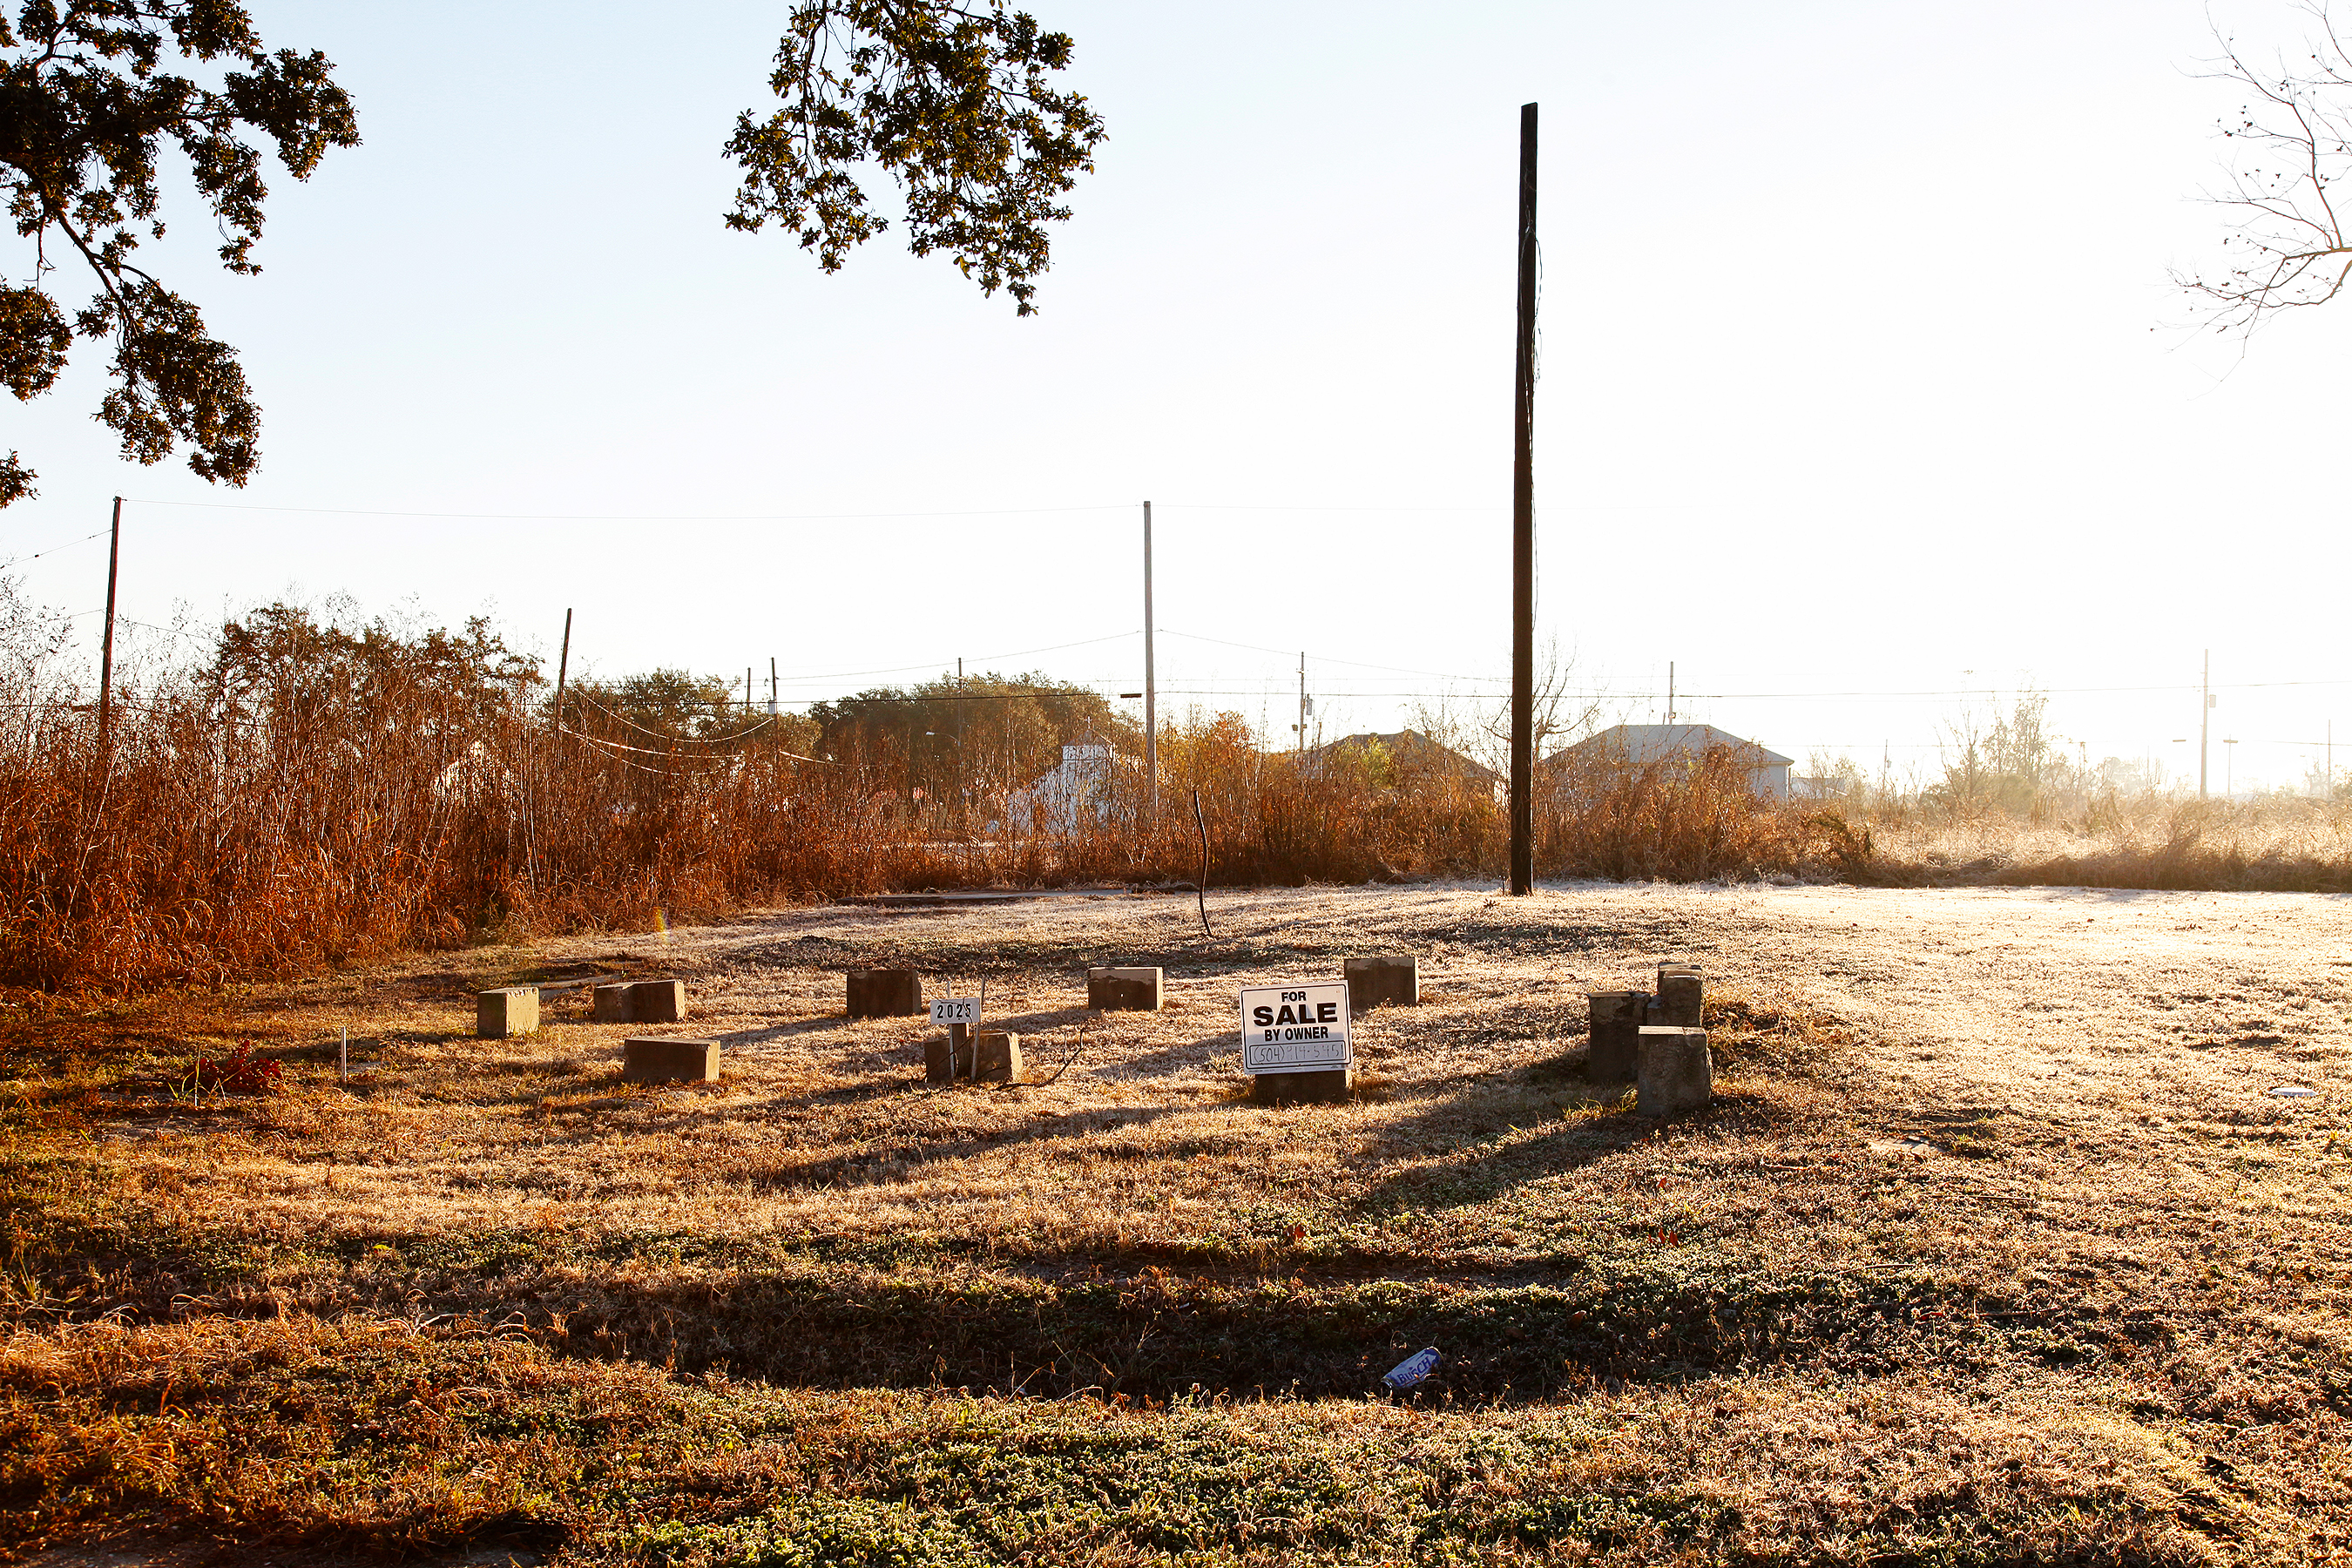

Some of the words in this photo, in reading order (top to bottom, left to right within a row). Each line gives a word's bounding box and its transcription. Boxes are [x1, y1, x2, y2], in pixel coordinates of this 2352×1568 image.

[1281, 991, 1307, 1002] FOR
[936, 1004, 971, 1018] 2025
[1253, 1003, 1338, 1027] SALE
[1264, 1029, 1281, 1042] BY
[1285, 1026, 1328, 1040] OWNER
[1397, 1355, 1431, 1383] BUSCH
